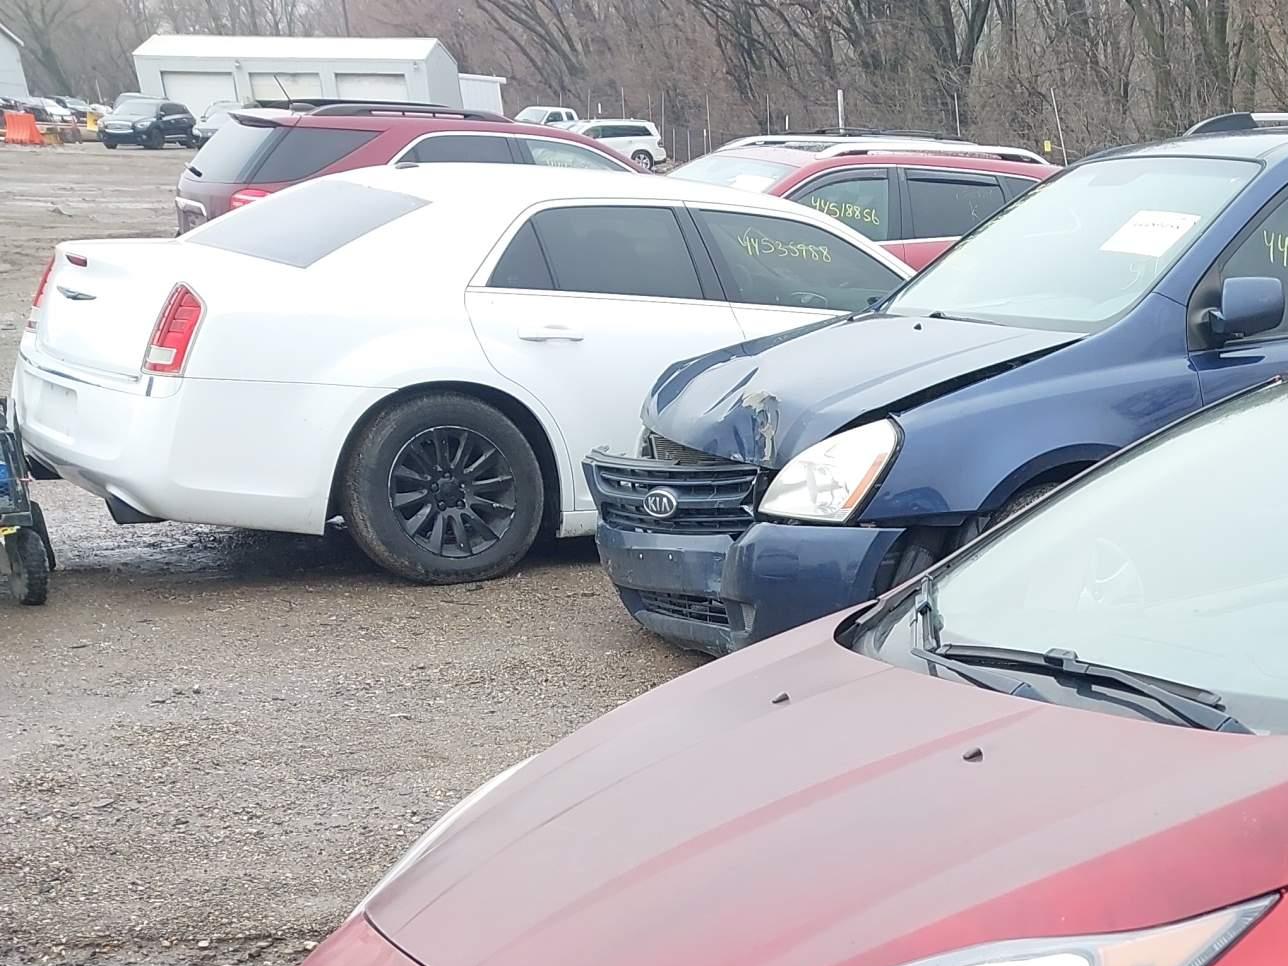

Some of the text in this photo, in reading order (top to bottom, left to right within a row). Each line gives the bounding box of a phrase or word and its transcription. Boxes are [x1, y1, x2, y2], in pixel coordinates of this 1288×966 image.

[811, 195, 880, 225] 44518856
[737, 229, 832, 263] 44535988
[648, 496, 670, 512] KIA
